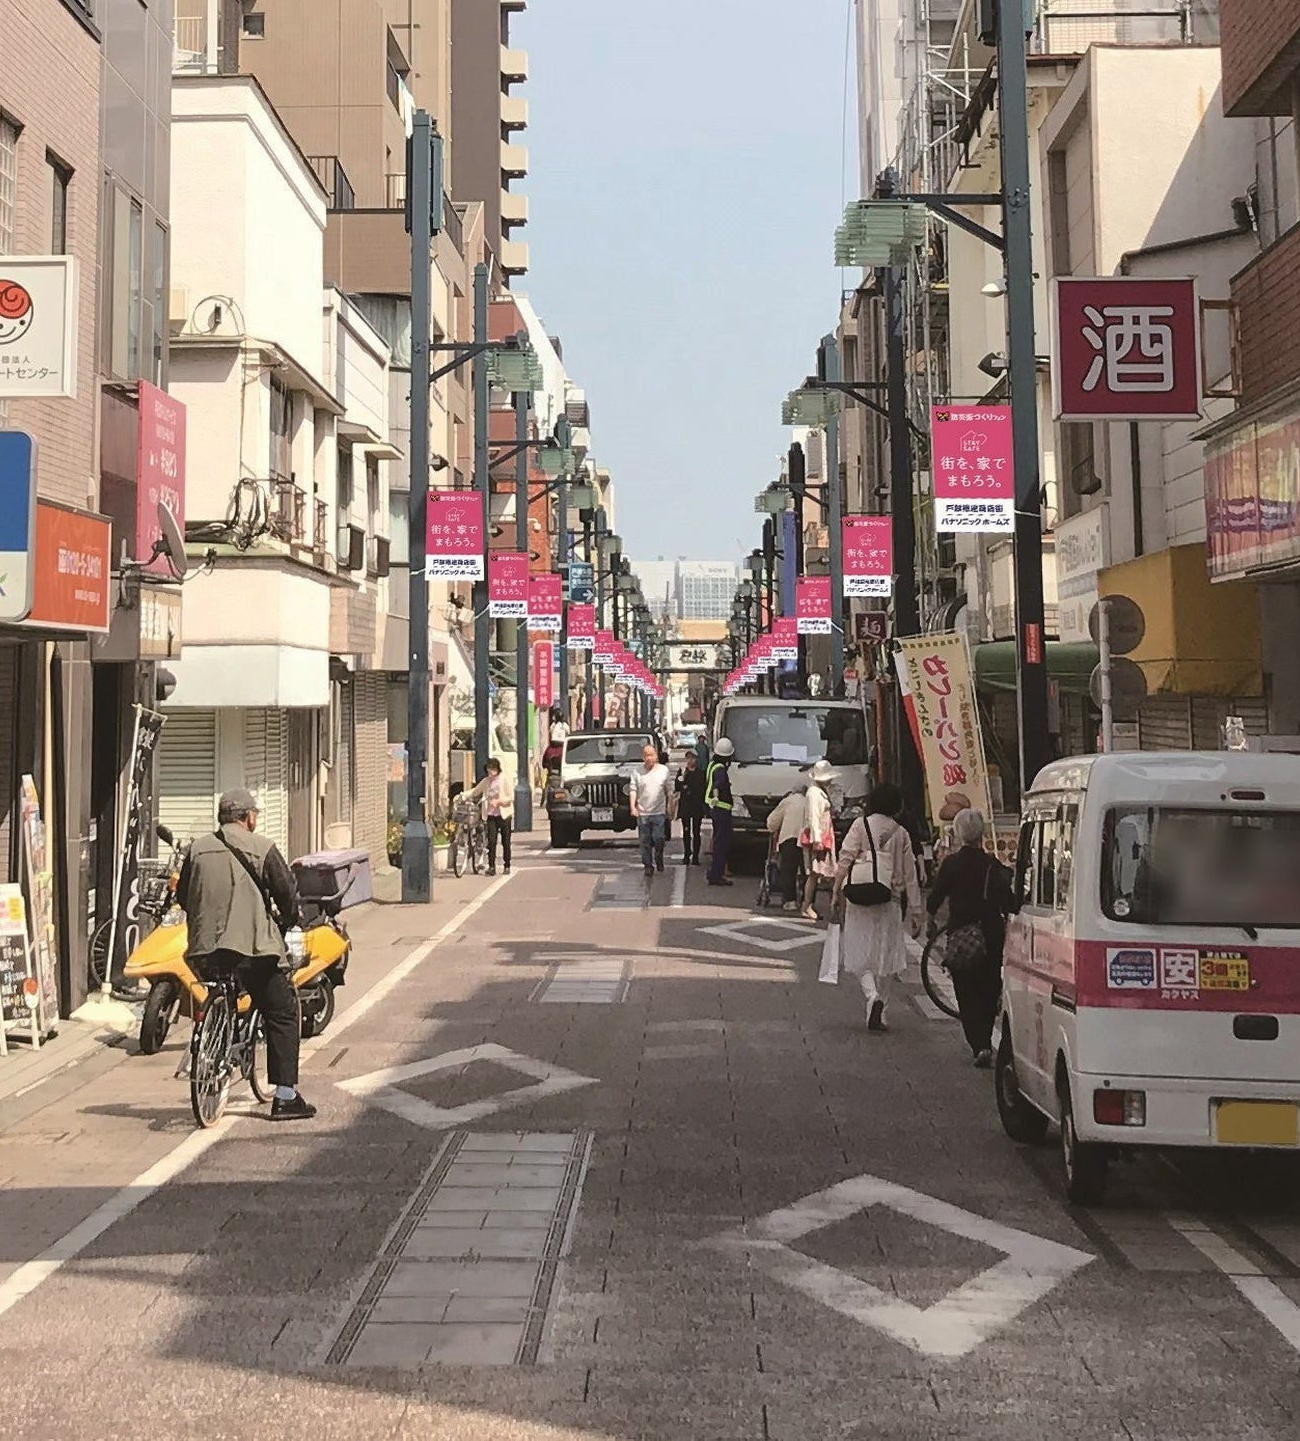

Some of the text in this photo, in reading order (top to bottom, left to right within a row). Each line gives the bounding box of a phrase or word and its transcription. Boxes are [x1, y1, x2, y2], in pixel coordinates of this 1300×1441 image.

[1082, 305, 1174, 393] 酒
[941, 456, 1007, 470] 街を、家で
[947, 474, 1002, 488] まもろう。
[1165, 953, 1195, 984] 安
[1161, 989, 1199, 1001] カクヤス
